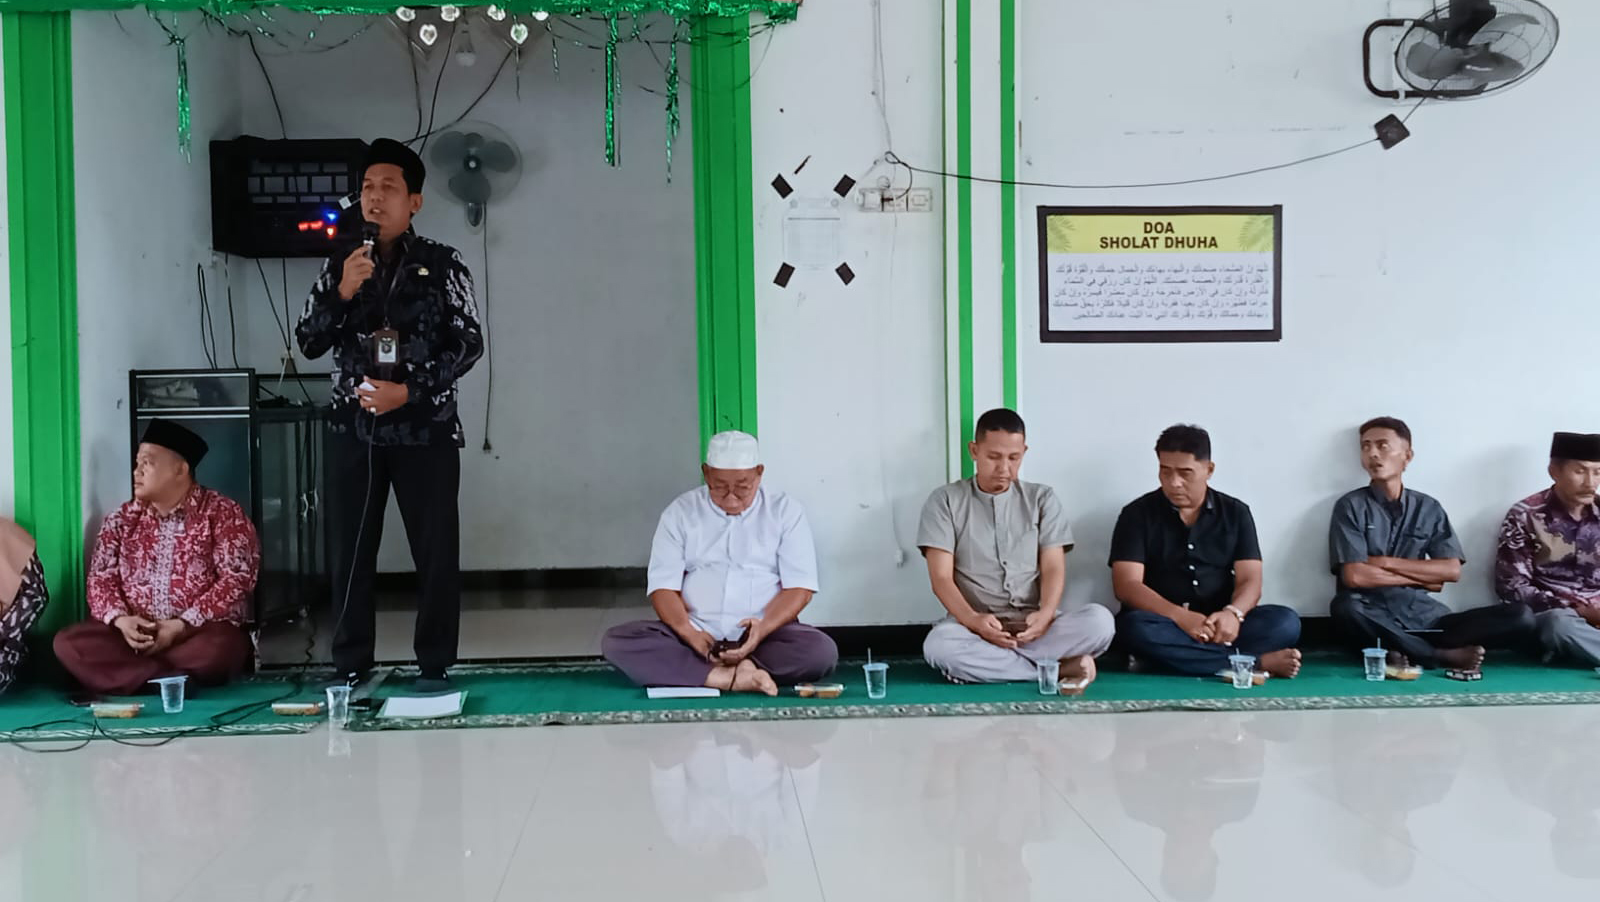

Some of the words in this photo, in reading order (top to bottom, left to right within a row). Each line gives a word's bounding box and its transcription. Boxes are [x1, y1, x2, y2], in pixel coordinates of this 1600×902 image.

[1143, 221, 1175, 234] DOA
[1099, 236, 1160, 249] SHOLAT
[1164, 236, 1219, 249] DHUHA
